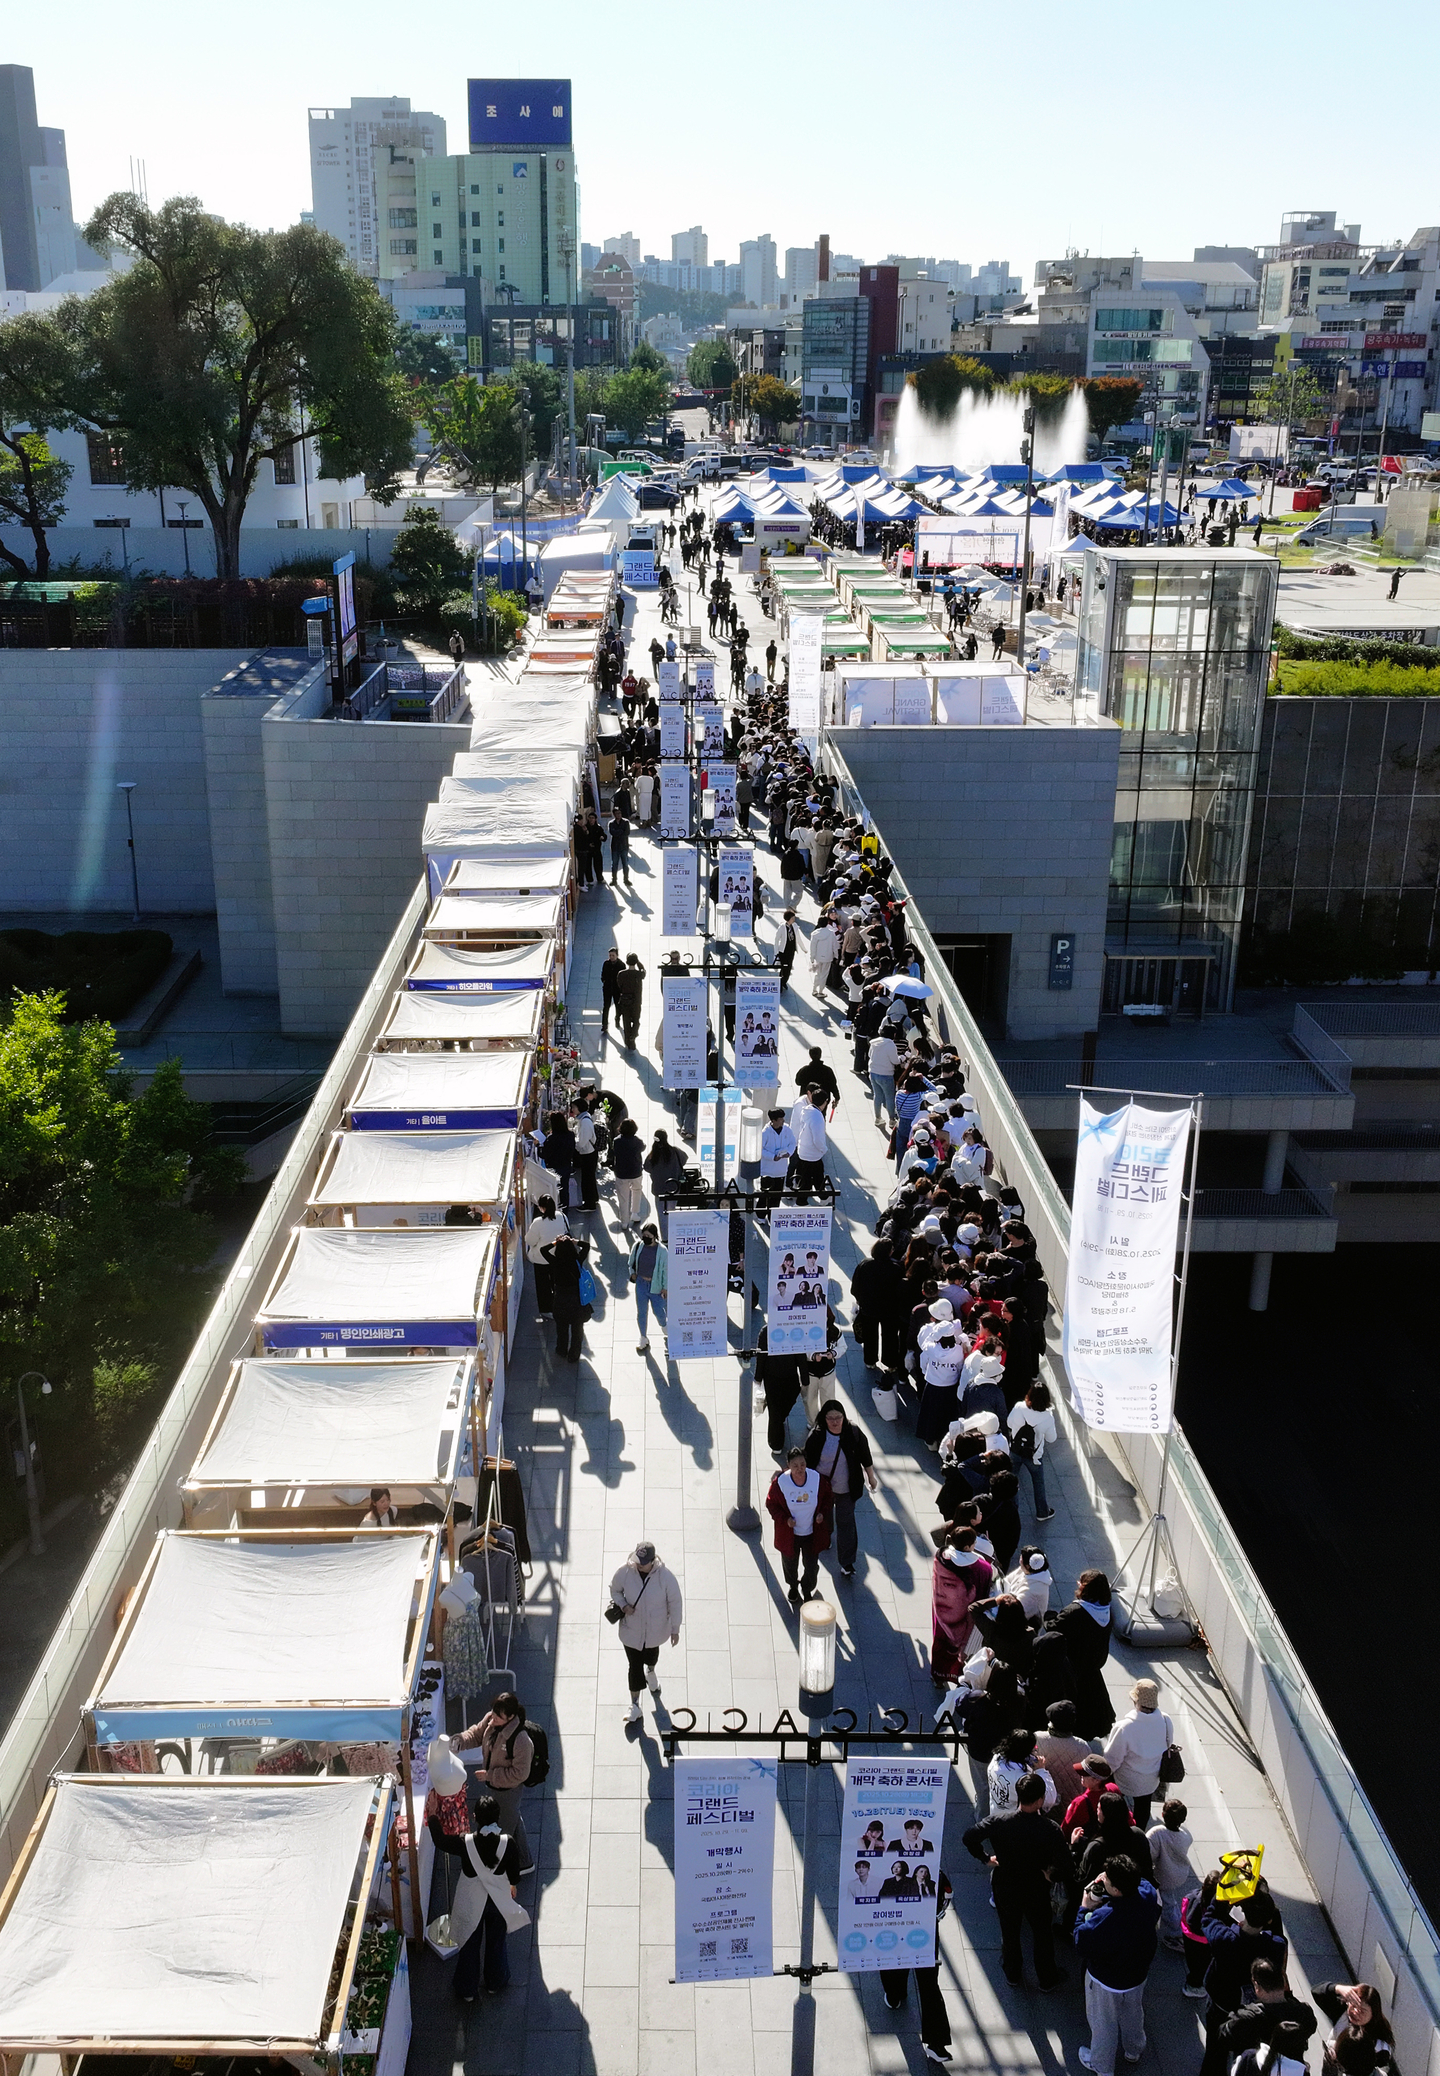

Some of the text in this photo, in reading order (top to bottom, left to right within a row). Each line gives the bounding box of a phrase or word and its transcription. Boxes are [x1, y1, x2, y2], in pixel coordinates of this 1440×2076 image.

[514, 182, 528, 246] 광주은행
[624, 562, 652, 572] 그랜드
[1057, 940, 1070, 954] P
[774, 1220, 788, 1228] 개막
[790, 1220, 805, 1228] 축하
[676, 1237, 706, 1246] 그랜드
[850, 1776, 943, 1786] 개막 축하 콘서트
[687, 1784, 740, 1796] 코리아
[687, 1797, 739, 1810] 그랜드
[706, 1846, 742, 1857] 개막행사
[710, 1910, 738, 1918] 프로그램
[873, 1910, 903, 1919] 참여방법
